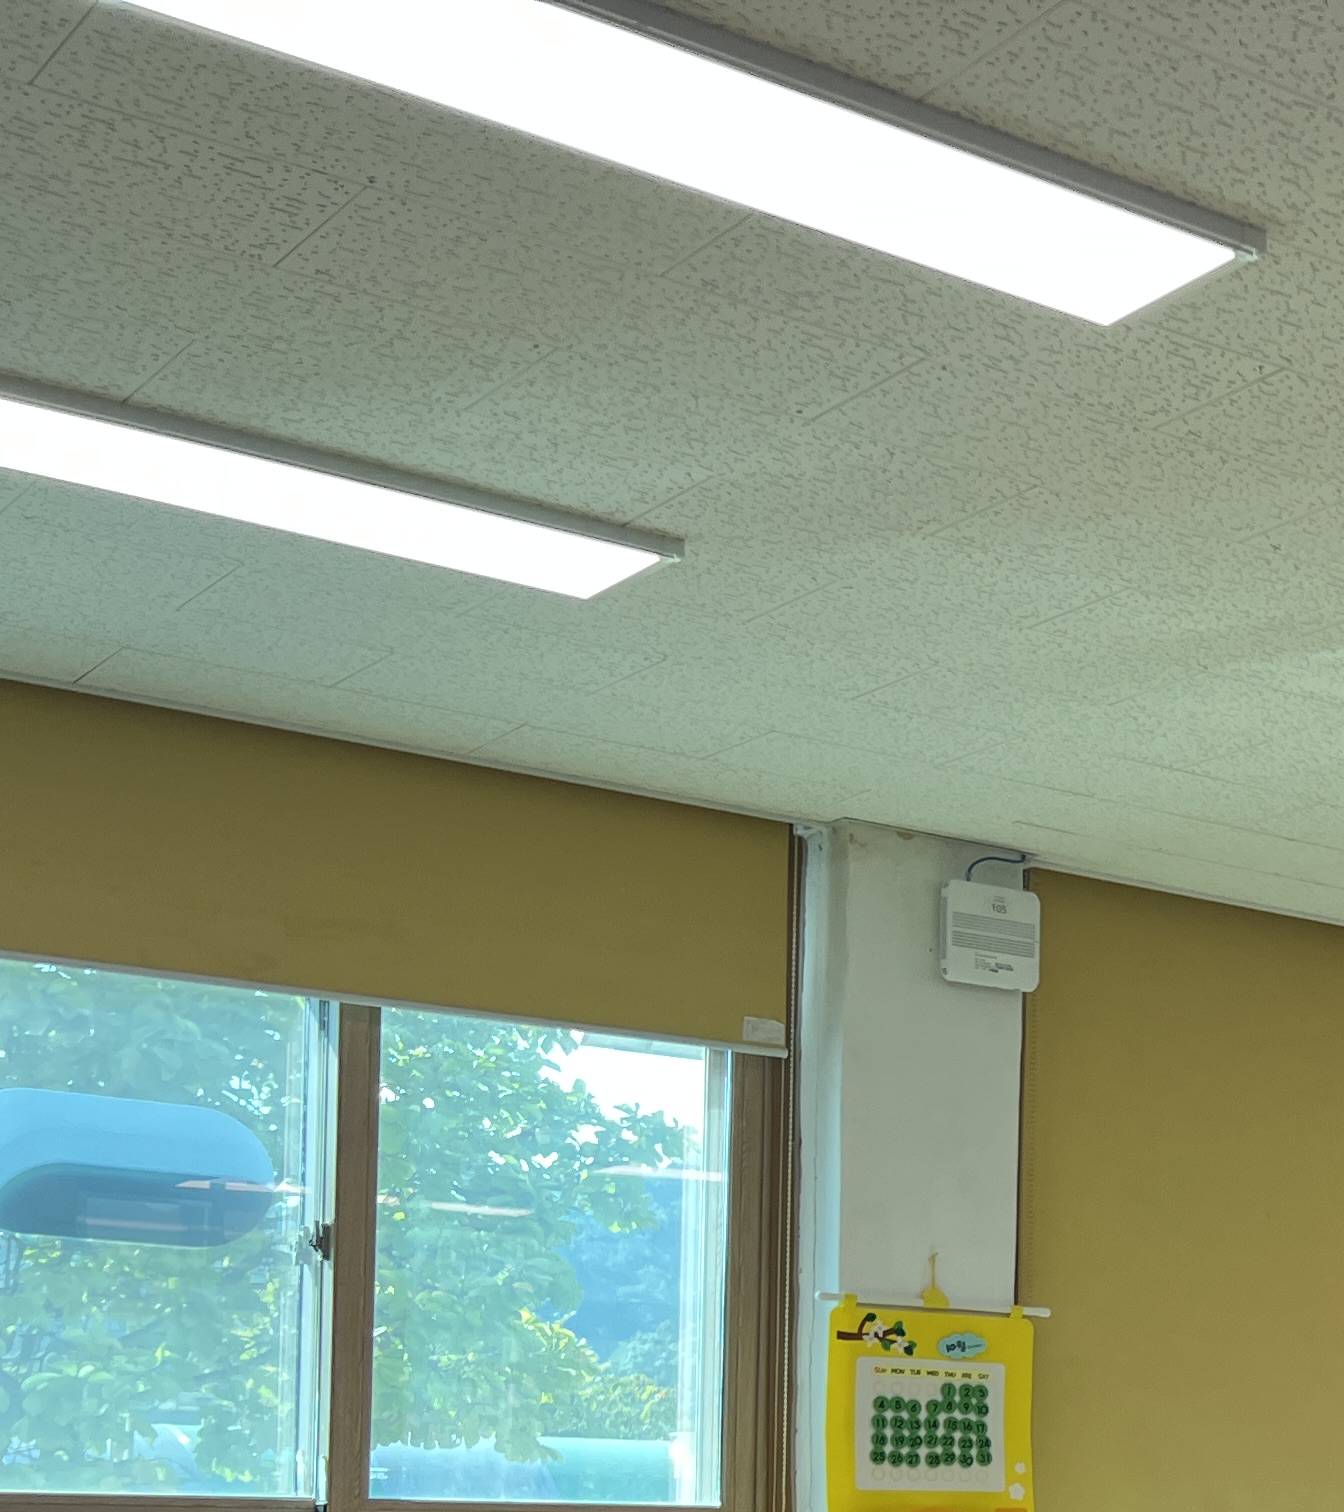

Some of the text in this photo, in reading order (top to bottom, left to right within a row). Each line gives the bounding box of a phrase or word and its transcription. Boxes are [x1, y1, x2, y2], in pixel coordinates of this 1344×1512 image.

[976, 1405, 989, 1414] 10
[876, 1419, 985, 1433] 11 12 13 14 15 16 17
[875, 1432, 991, 1449] 18 19 20 21 22 23 24
[874, 1451, 992, 1466] 25 26 27 28 29 30 31
